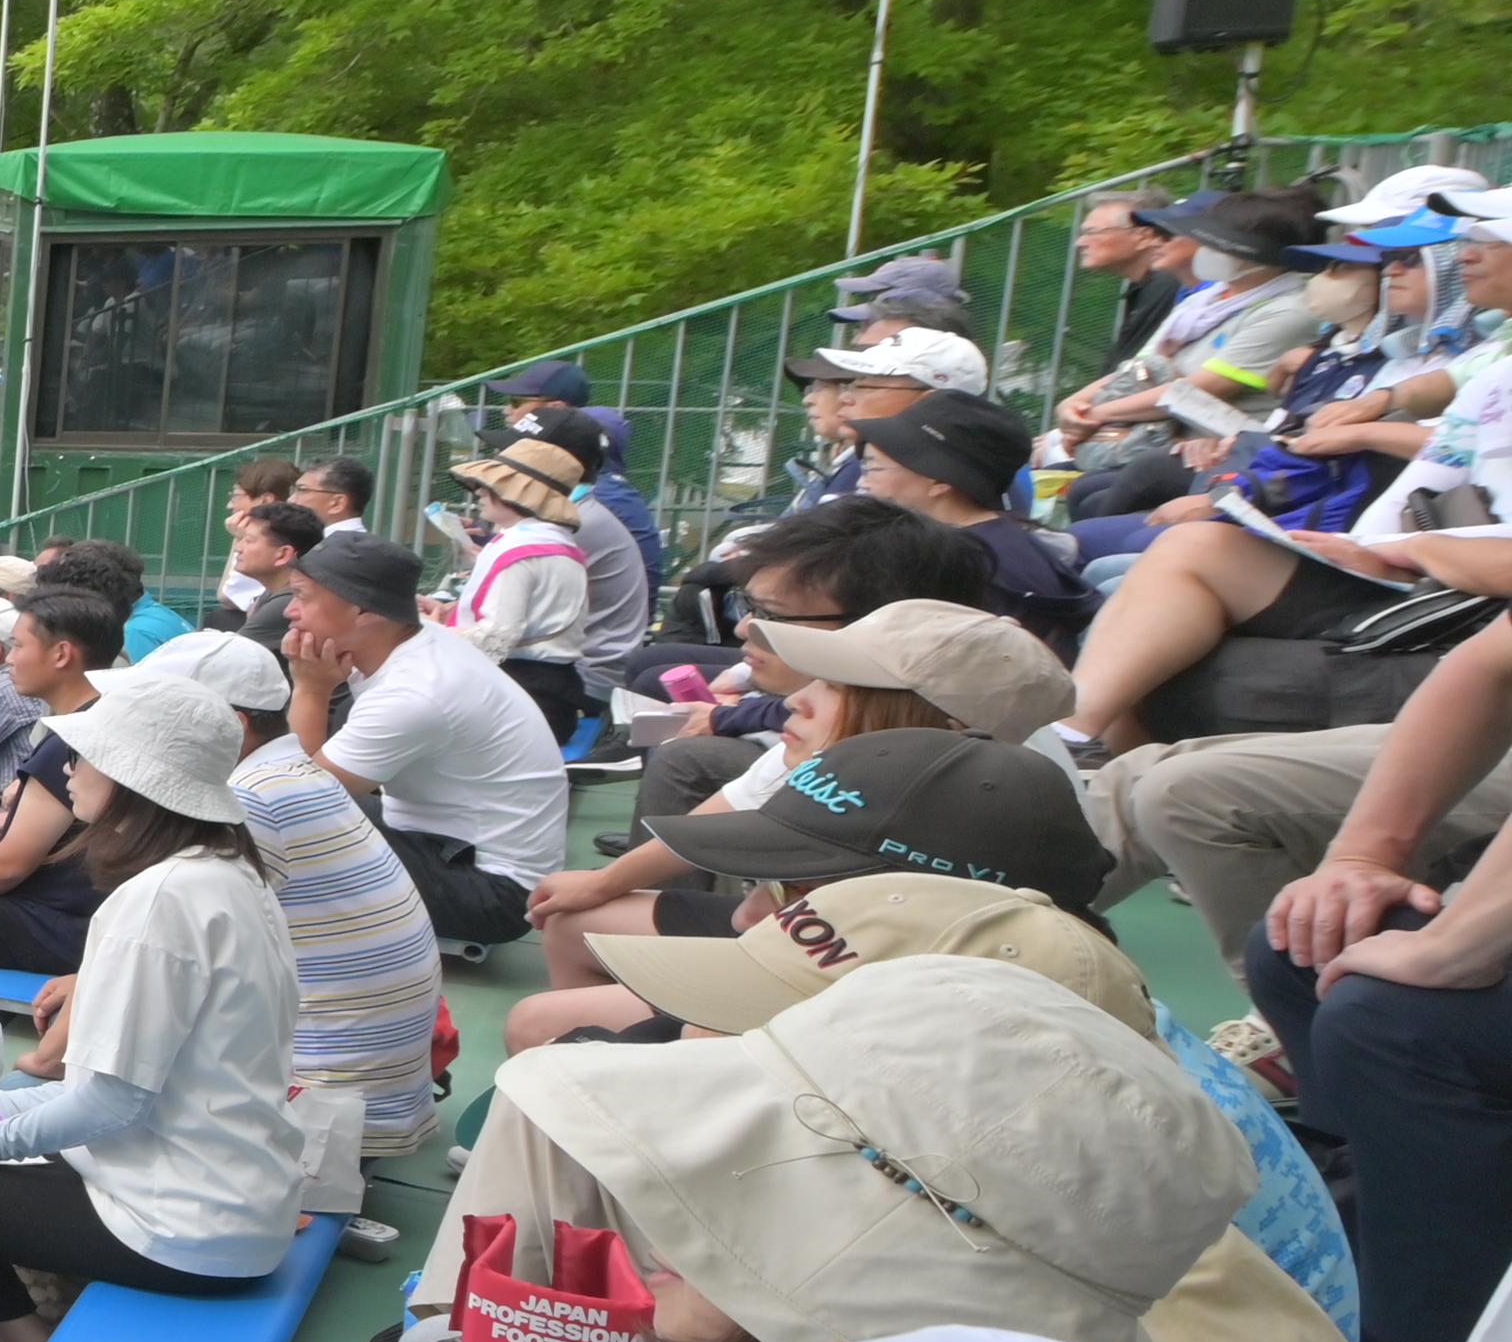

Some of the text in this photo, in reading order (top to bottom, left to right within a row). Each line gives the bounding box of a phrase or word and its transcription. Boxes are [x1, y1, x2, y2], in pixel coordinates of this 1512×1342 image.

[788, 751, 865, 813] leist
[878, 838, 1006, 885] PRO V1
[520, 1295, 608, 1326] JAPAN
